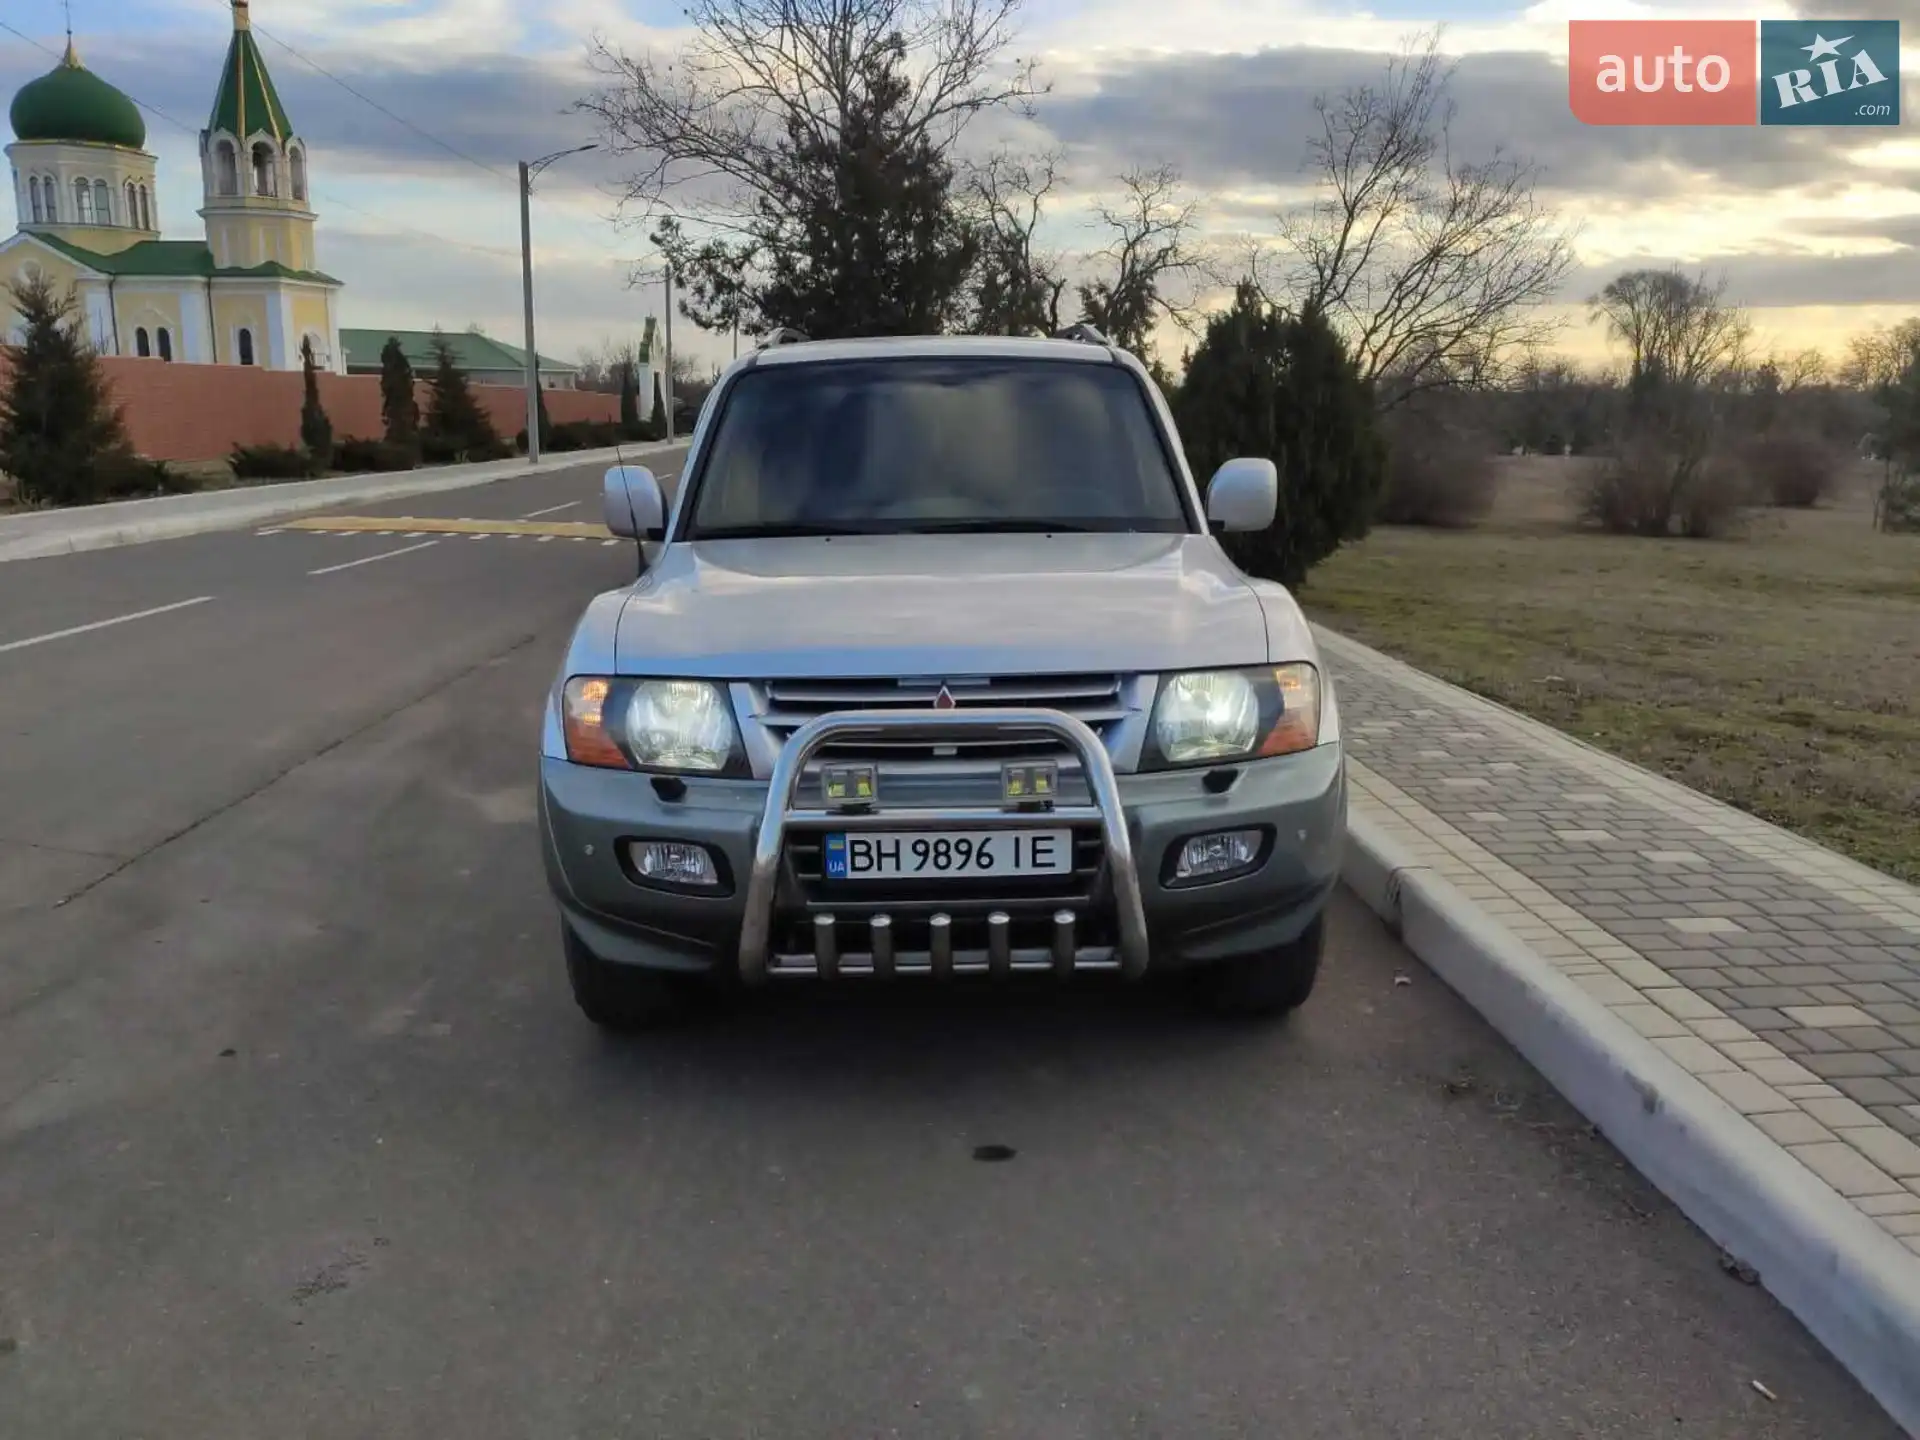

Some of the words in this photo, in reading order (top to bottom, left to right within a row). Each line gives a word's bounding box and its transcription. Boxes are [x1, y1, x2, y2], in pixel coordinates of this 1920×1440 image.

[828, 860, 845, 873] UA
[849, 839, 901, 873] BH
[911, 837, 995, 872] 9896
[1014, 836, 1056, 869] IE
